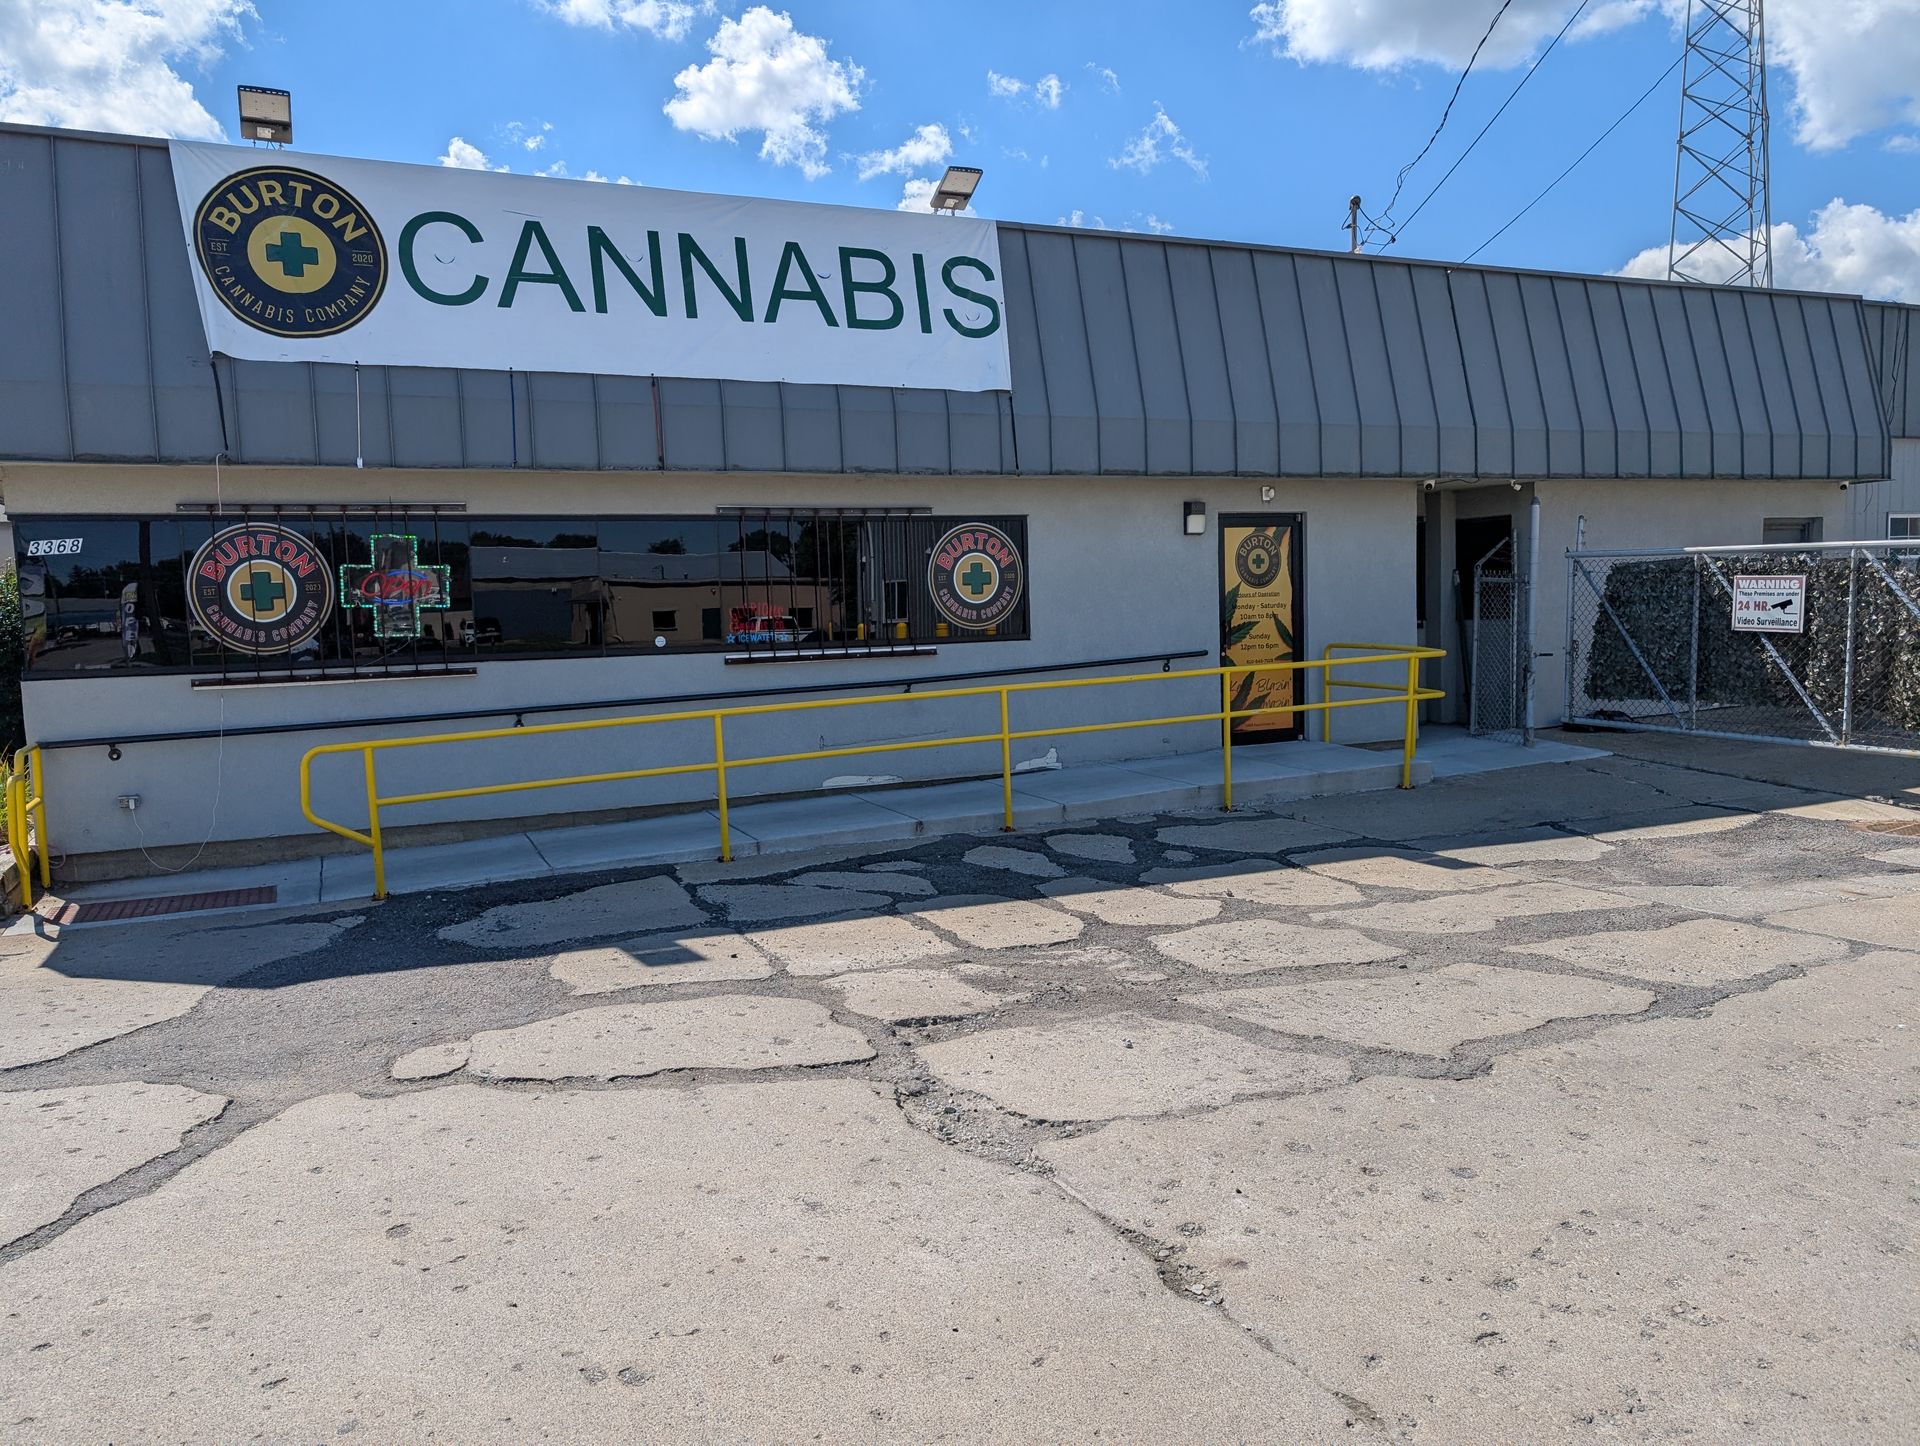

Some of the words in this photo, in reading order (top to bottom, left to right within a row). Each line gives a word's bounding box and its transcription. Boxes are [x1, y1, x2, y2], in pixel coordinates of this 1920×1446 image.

[208, 180, 368, 243] BURTON
[211, 242, 227, 252] EST
[352, 253, 373, 264] 2020
[398, 211, 1001, 339] CANNABIS
[215, 265, 294, 323] CANNABIS
[305, 276, 371, 323] COMPANY
[29, 539, 80, 555] 3368
[936, 532, 1014, 571] BURTON
[1240, 536, 1277, 557] BURTON
[200, 534, 318, 583] BURTON
[203, 588, 216, 596] EST
[1738, 579, 1800, 589] WARNING
[939, 588, 977, 620] CANNABIS
[981, 586, 1014, 619] COMPANY
[1738, 600, 1750, 611] 24
[1753, 600, 1771, 611] HR.
[272, 600, 319, 641] COMPANY
[1737, 616, 1754, 625] Video
[1757, 617, 1798, 627] Surveillance
[1240, 643, 1257, 651] 12pm
[1255, 677, 1292, 693] Blazin'
